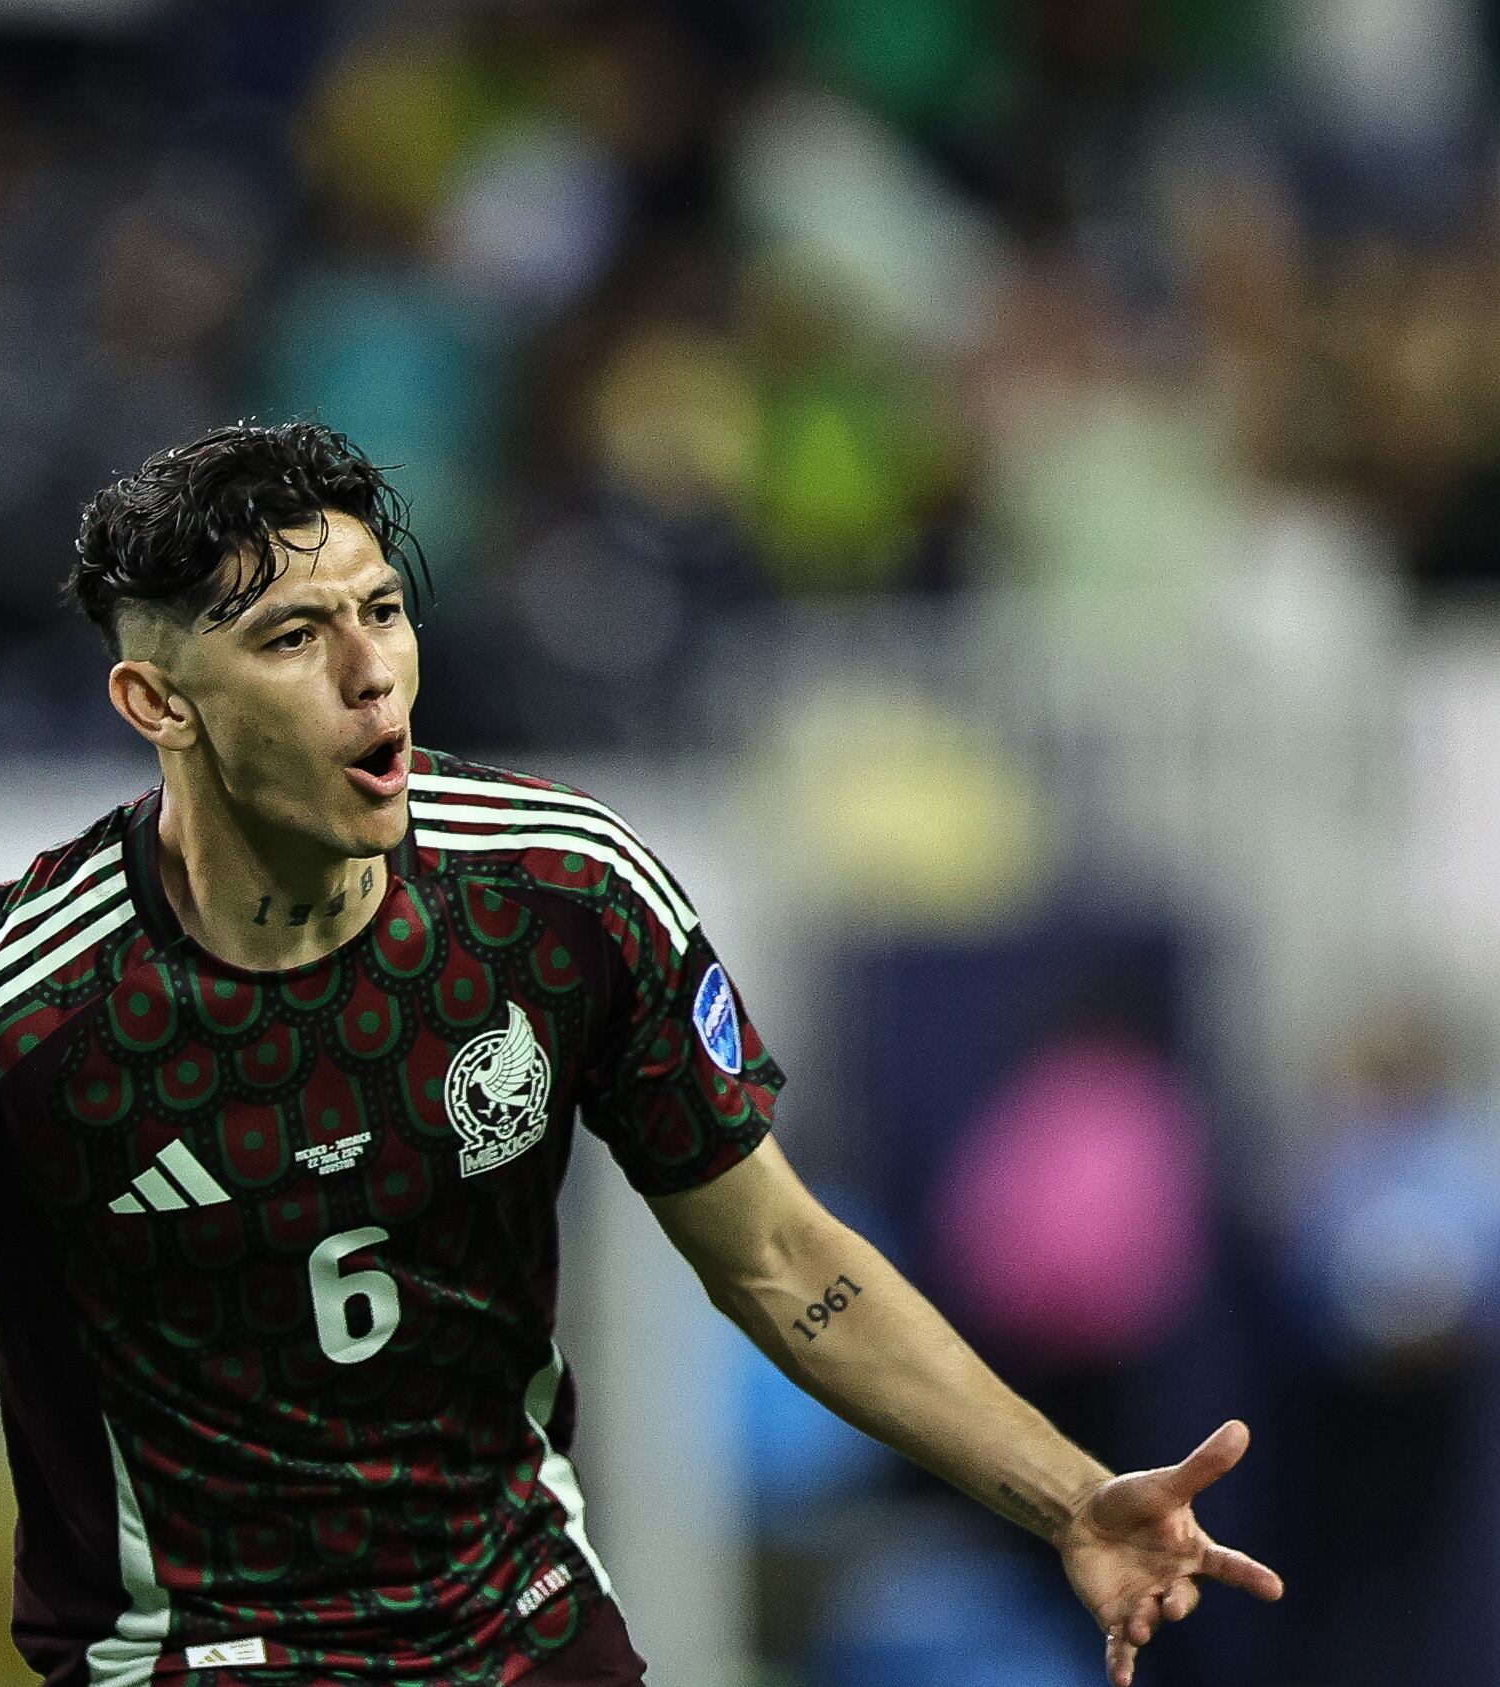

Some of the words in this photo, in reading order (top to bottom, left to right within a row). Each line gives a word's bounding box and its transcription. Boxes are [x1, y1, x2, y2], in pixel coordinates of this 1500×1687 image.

[465, 1125, 545, 1172] MÉXICO
[308, 1226, 401, 1364] 6
[793, 1274, 863, 1343] 1961
